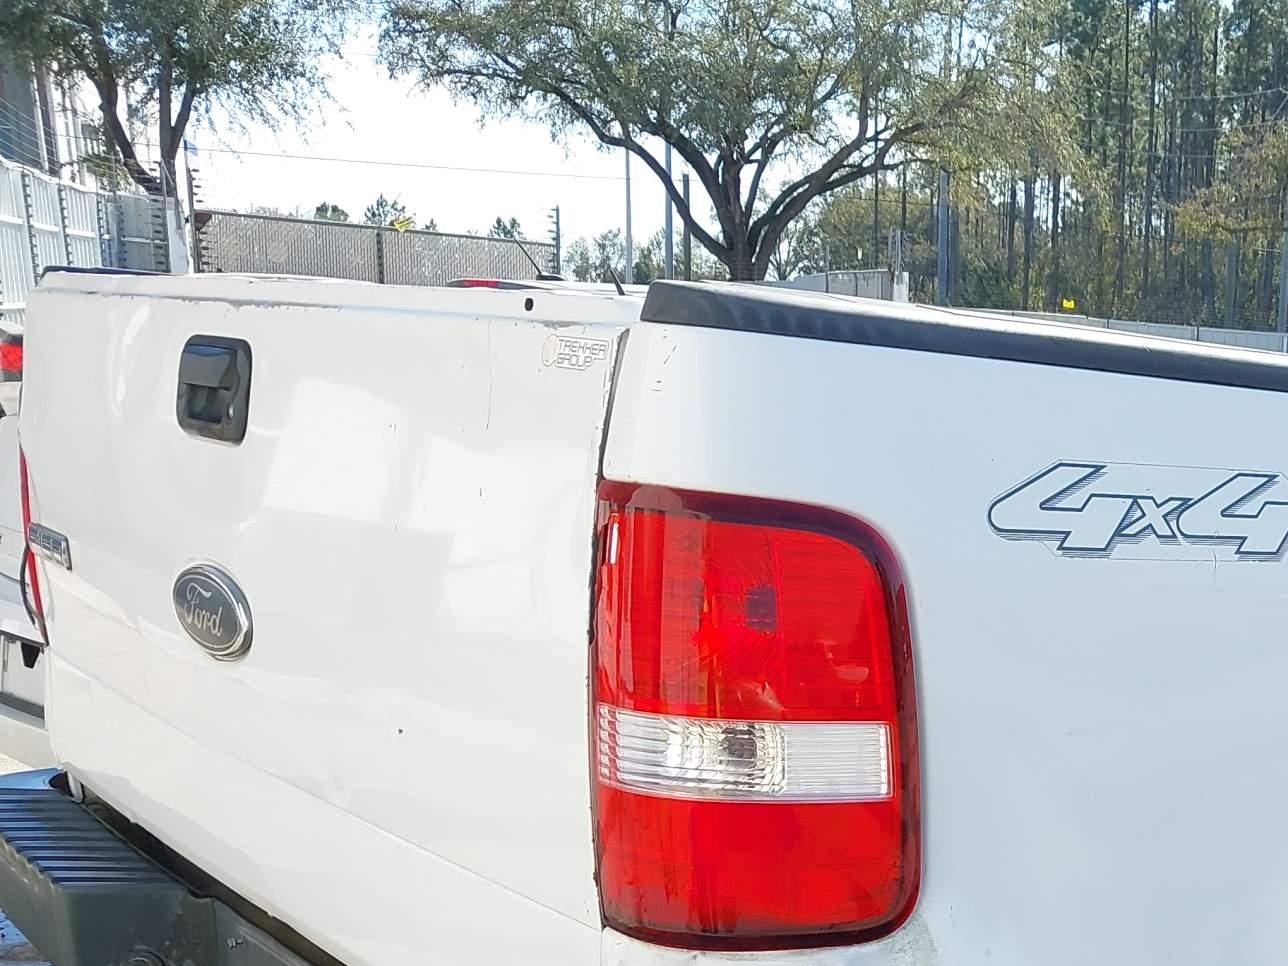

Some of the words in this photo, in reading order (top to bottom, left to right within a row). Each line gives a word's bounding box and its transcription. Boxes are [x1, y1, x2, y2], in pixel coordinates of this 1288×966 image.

[558, 338, 607, 356] TREKKER
[556, 352, 593, 368] GROUP
[184, 582, 224, 638] Ford
